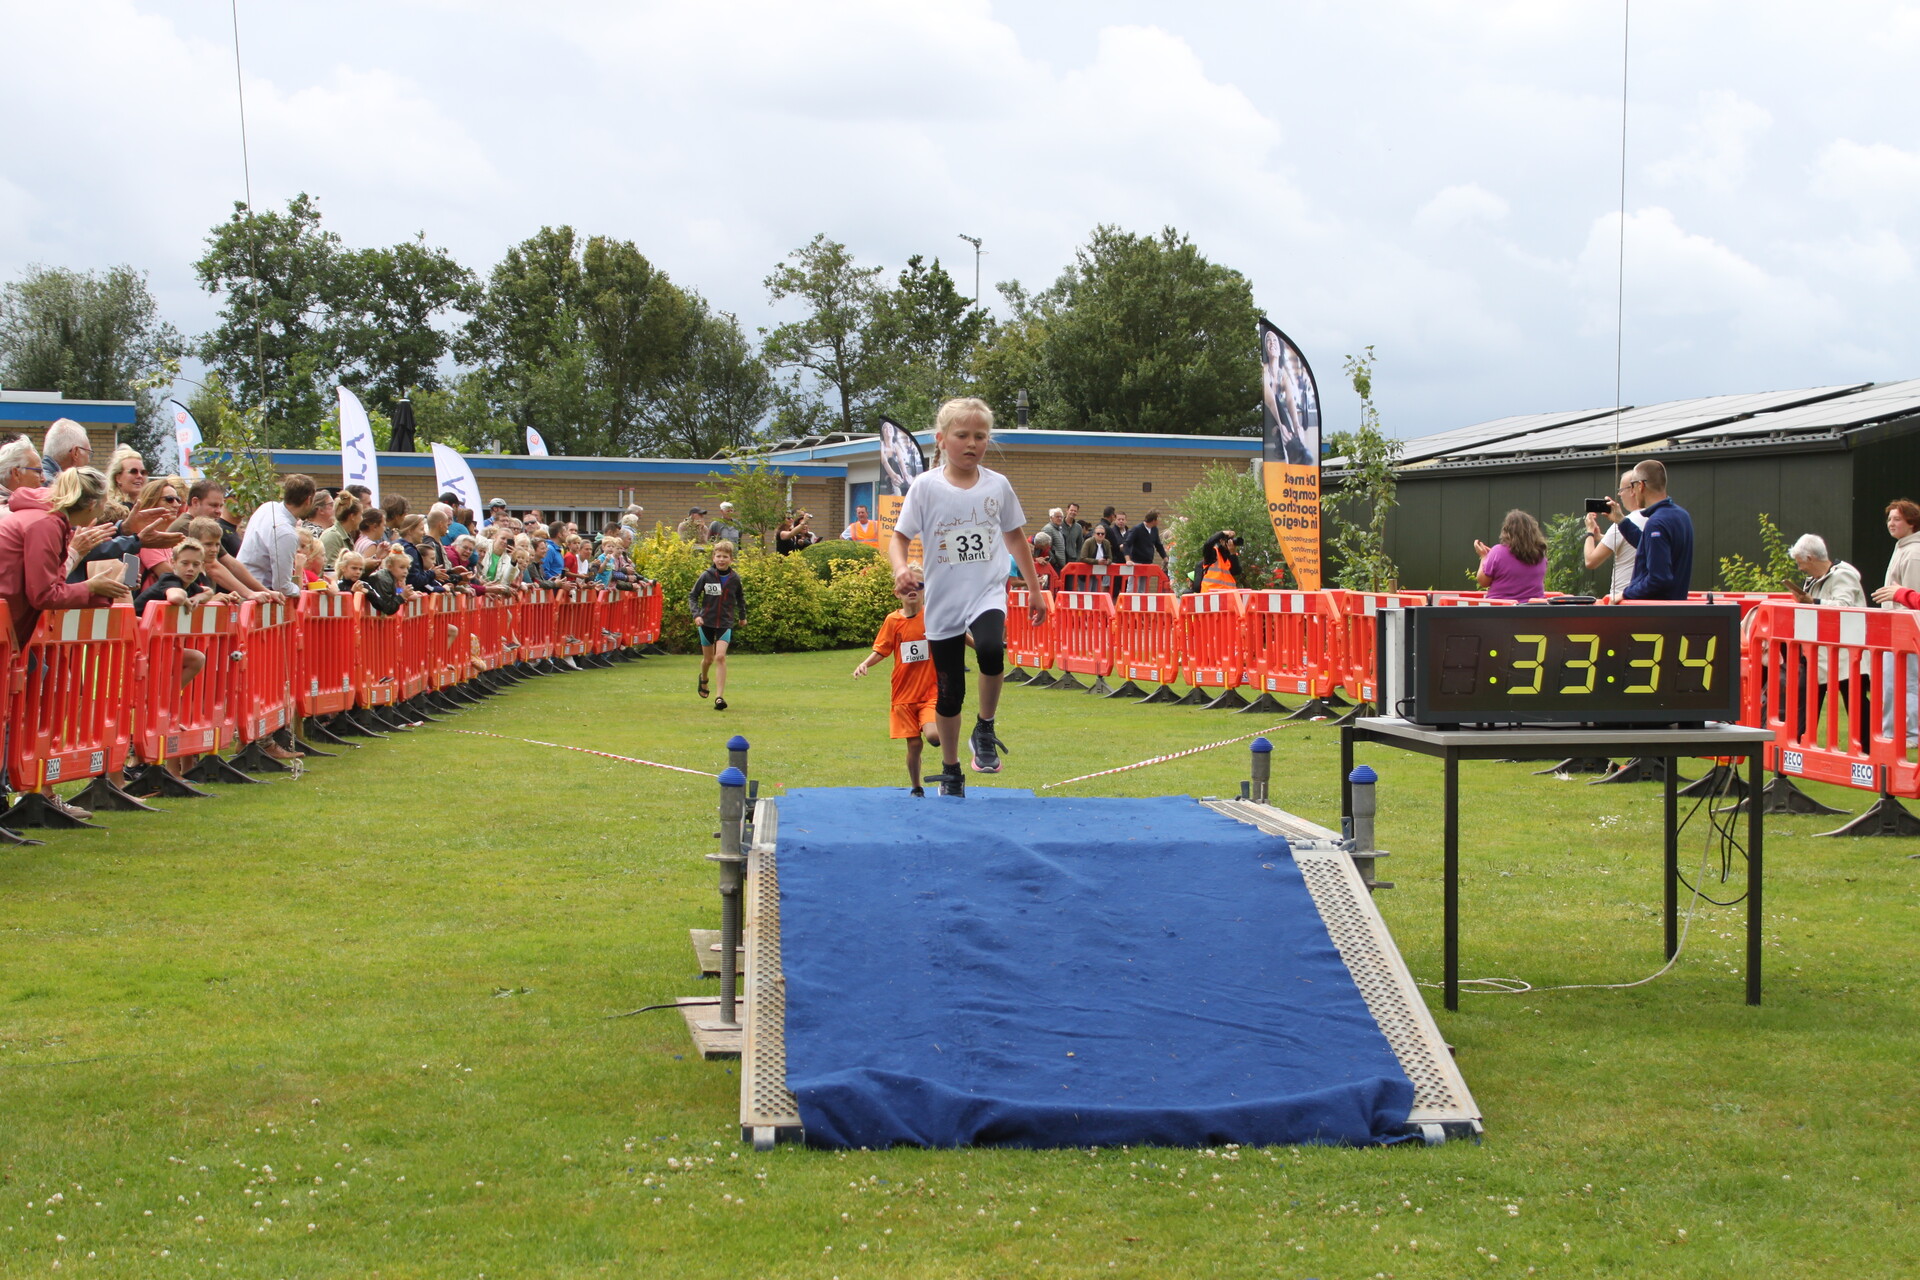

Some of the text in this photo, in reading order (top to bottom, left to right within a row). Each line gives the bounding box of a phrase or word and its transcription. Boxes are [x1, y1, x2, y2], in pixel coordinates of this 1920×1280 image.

[956, 534, 983, 553] 33
[958, 550, 985, 562] Marit
[910, 644, 919, 655] 6
[47, 758, 60, 774] RECO
[91, 751, 103, 766] RECO
[1784, 751, 1802, 766] RECO
[1852, 764, 1873, 779] RECO
